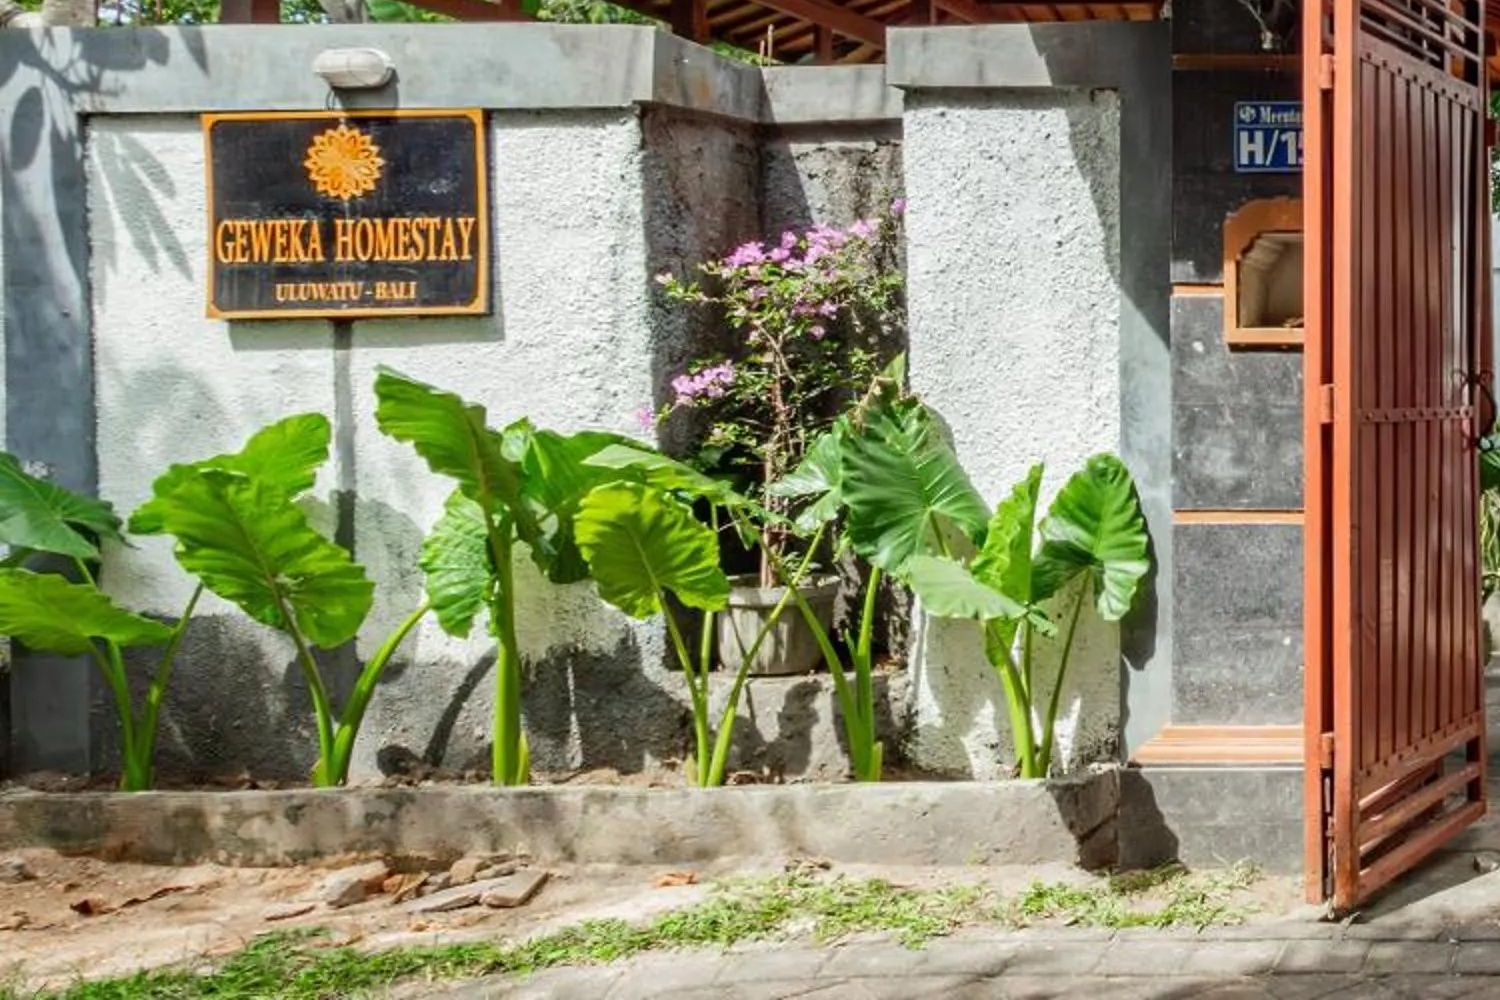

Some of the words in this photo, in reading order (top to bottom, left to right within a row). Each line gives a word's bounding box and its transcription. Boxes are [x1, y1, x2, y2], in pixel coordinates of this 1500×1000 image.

[216, 218, 325, 264] GEWEKA
[334, 216, 475, 262] HOMESTAY
[275, 281, 363, 301] ULUWATU
[375, 281, 417, 299] BALI
